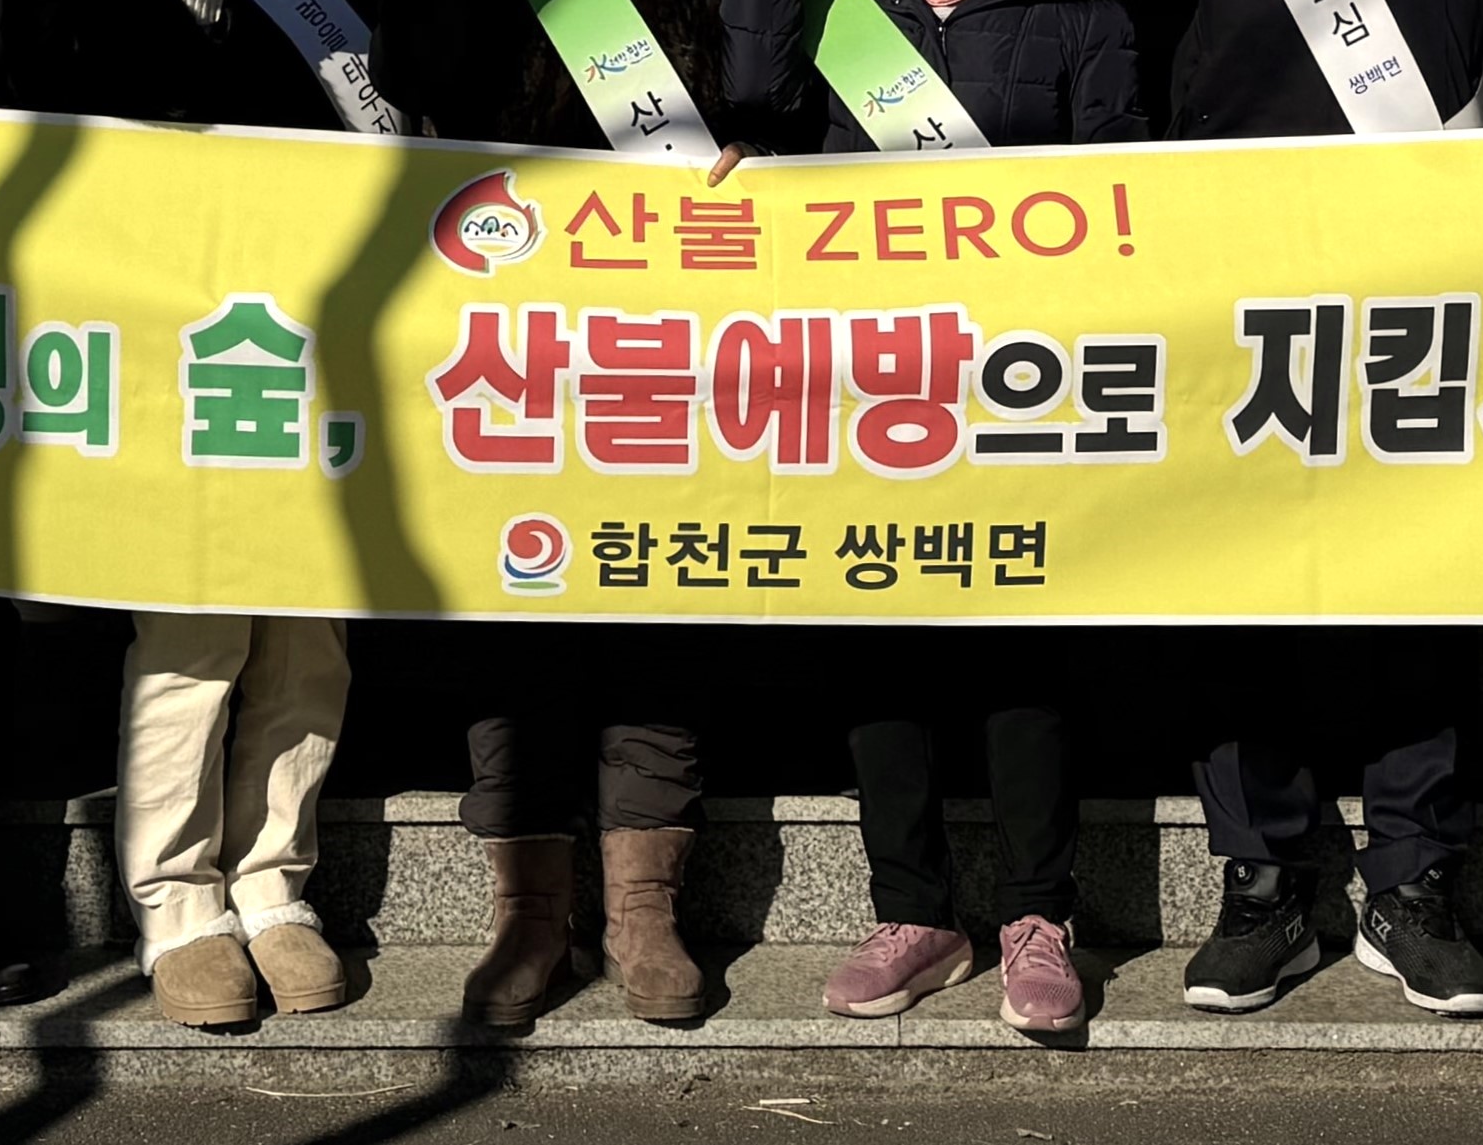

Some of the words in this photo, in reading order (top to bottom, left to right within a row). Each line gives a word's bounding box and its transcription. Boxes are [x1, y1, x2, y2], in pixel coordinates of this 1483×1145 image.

[1348, 57, 1403, 95] 쌍백면
[565, 190, 762, 271] 산불
[806, 183, 1135, 262] ZERO!
[180, 292, 363, 478] 숲,
[431, 305, 1164, 477] 산불예방으로
[589, 520, 808, 589] 합천군
[836, 520, 1048, 589] 쌍백면
